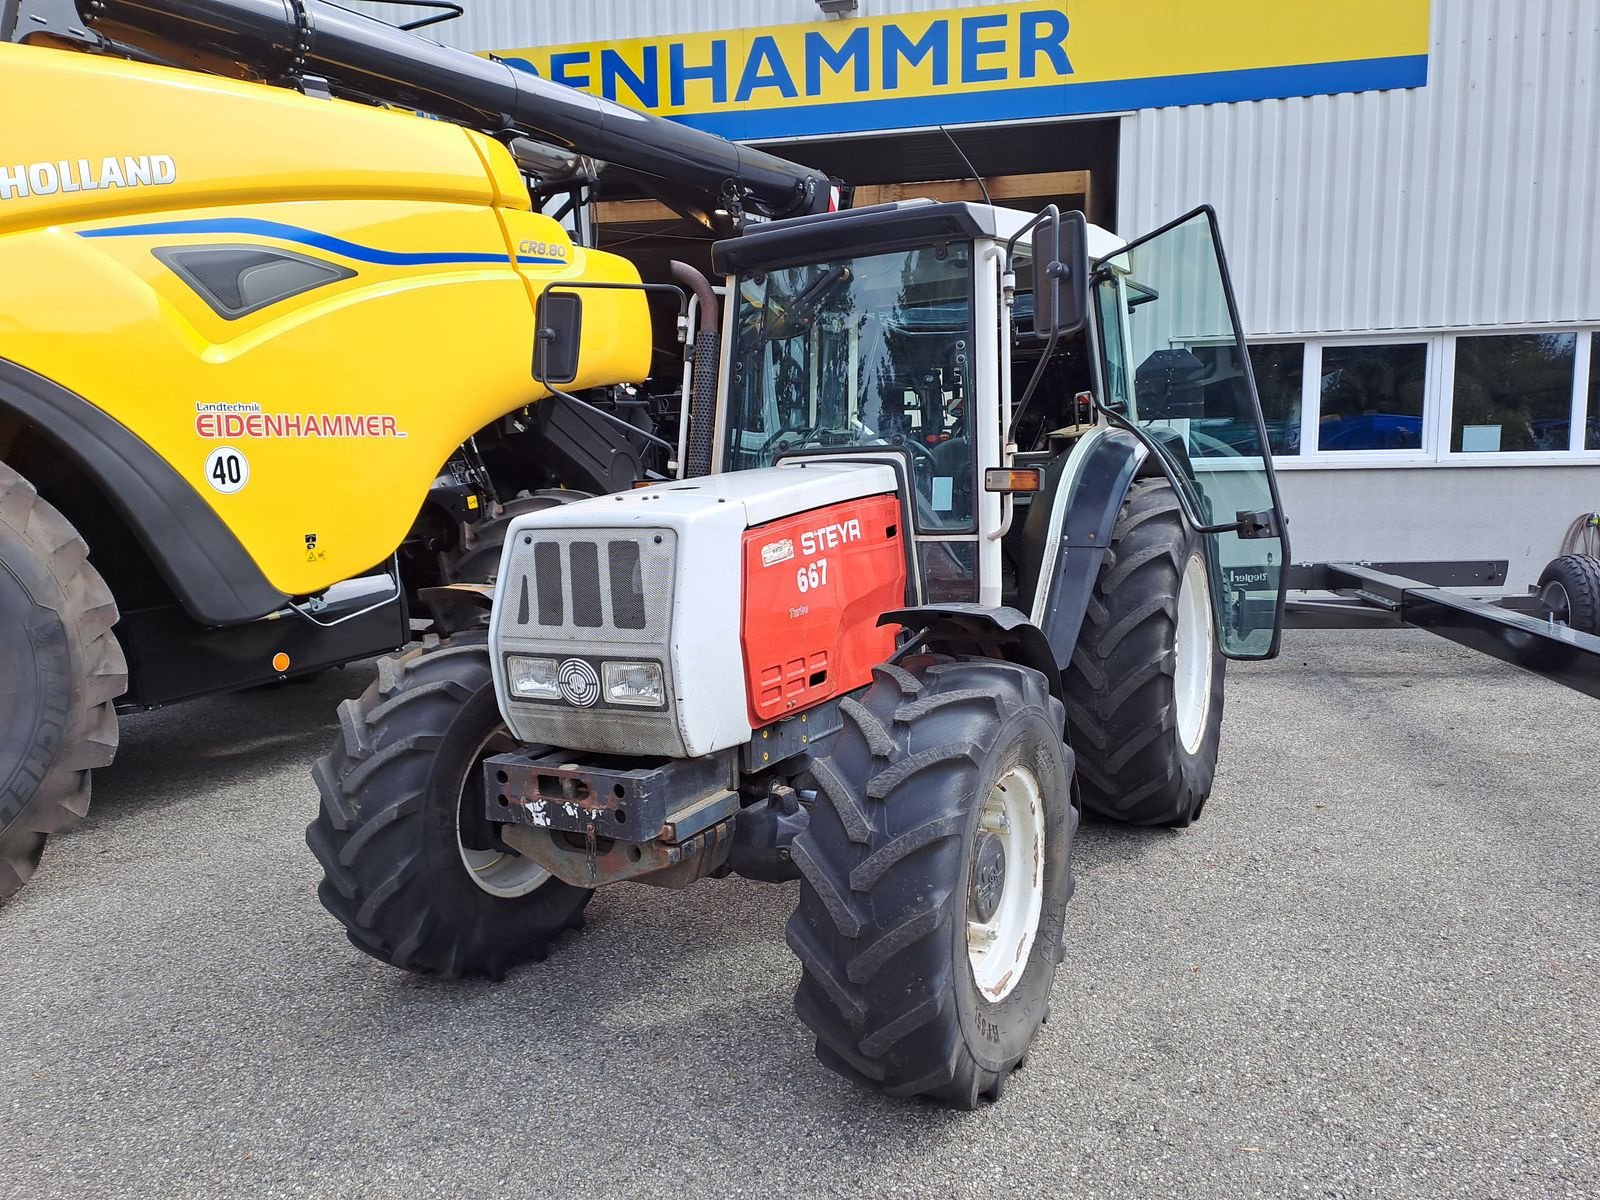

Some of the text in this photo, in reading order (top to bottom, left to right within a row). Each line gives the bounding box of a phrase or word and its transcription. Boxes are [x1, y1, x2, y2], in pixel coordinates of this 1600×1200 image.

[502, 9, 1075, 109] ENHAMMER
[0, 154, 176, 200] HOLLAND
[519, 240, 566, 257] CR8.80
[196, 402, 261, 412] Landtechnik
[196, 414, 397, 437] EIDENHAMMER
[213, 455, 241, 485] 40
[800, 518, 862, 556] STEYR
[796, 558, 828, 593] 667
